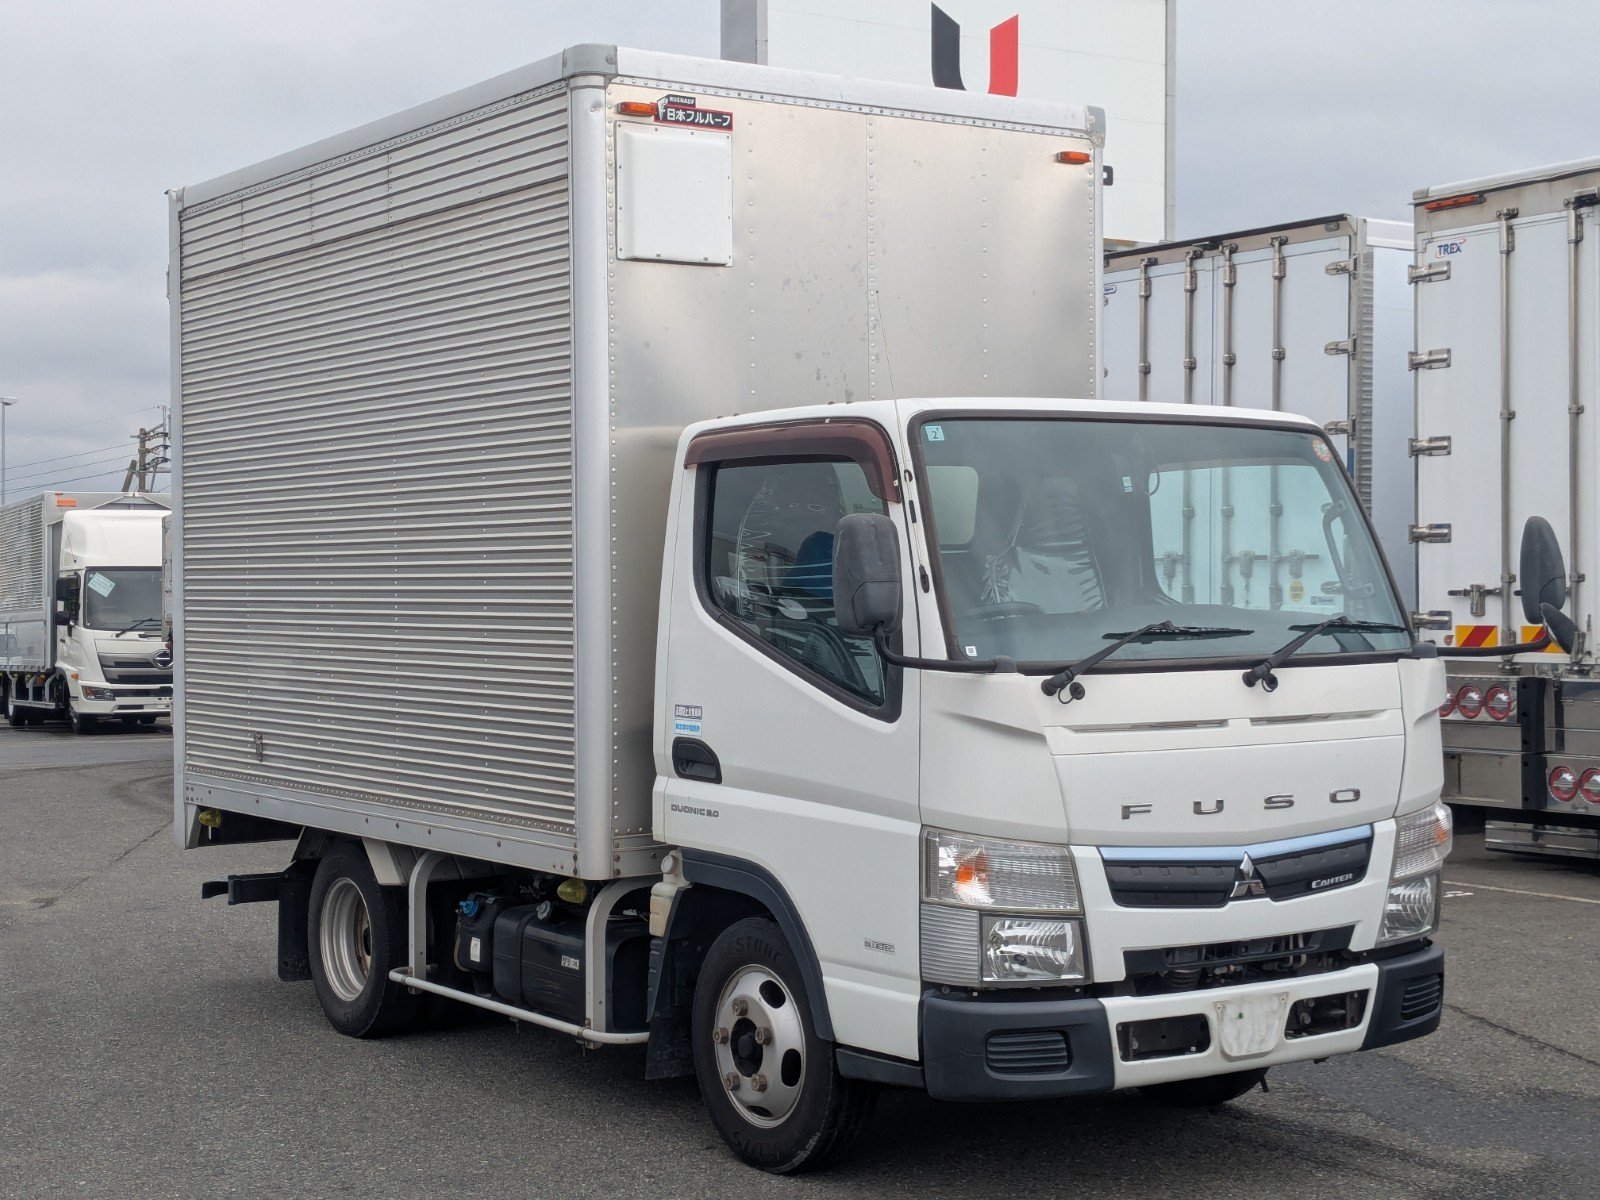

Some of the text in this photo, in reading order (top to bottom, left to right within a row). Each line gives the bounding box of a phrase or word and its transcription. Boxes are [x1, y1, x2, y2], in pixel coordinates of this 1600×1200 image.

[667, 108, 731, 126] 日本フルハーフ
[1437, 243, 1462, 255] TREX
[671, 804, 706, 816] DUONIC
[1121, 788, 1361, 820] FUSO
